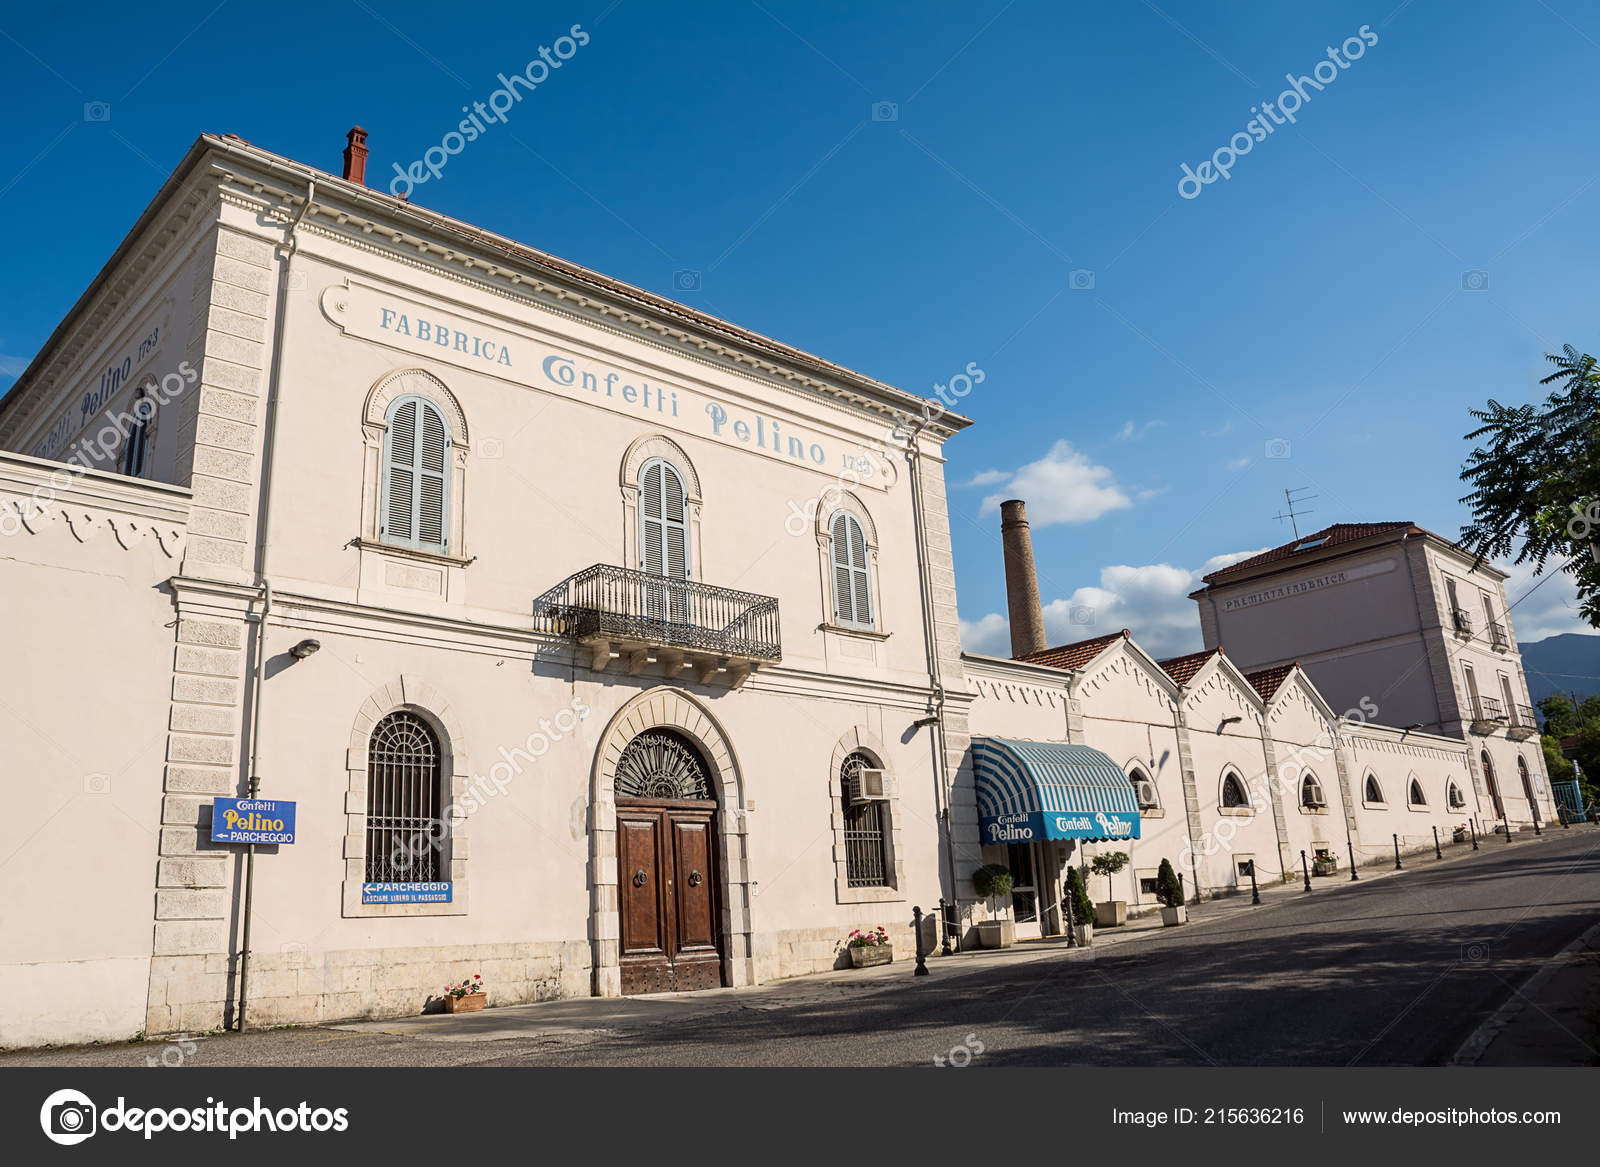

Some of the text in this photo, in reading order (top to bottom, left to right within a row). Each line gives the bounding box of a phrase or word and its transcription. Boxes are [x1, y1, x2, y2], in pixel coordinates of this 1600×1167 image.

[80, 356, 131, 428] Pelino
[380, 307, 513, 367] FABBRICA
[542, 354, 680, 417] Confetti
[705, 402, 825, 465] Pelino
[236, 800, 275, 811] Confetti
[222, 809, 284, 831] Pelino
[1096, 811, 1132, 836] Pelino
[230, 831, 293, 843] PARCHEGGIO
[988, 822, 1033, 841] Pelino
[376, 882, 449, 892] PARCHEGGIO
